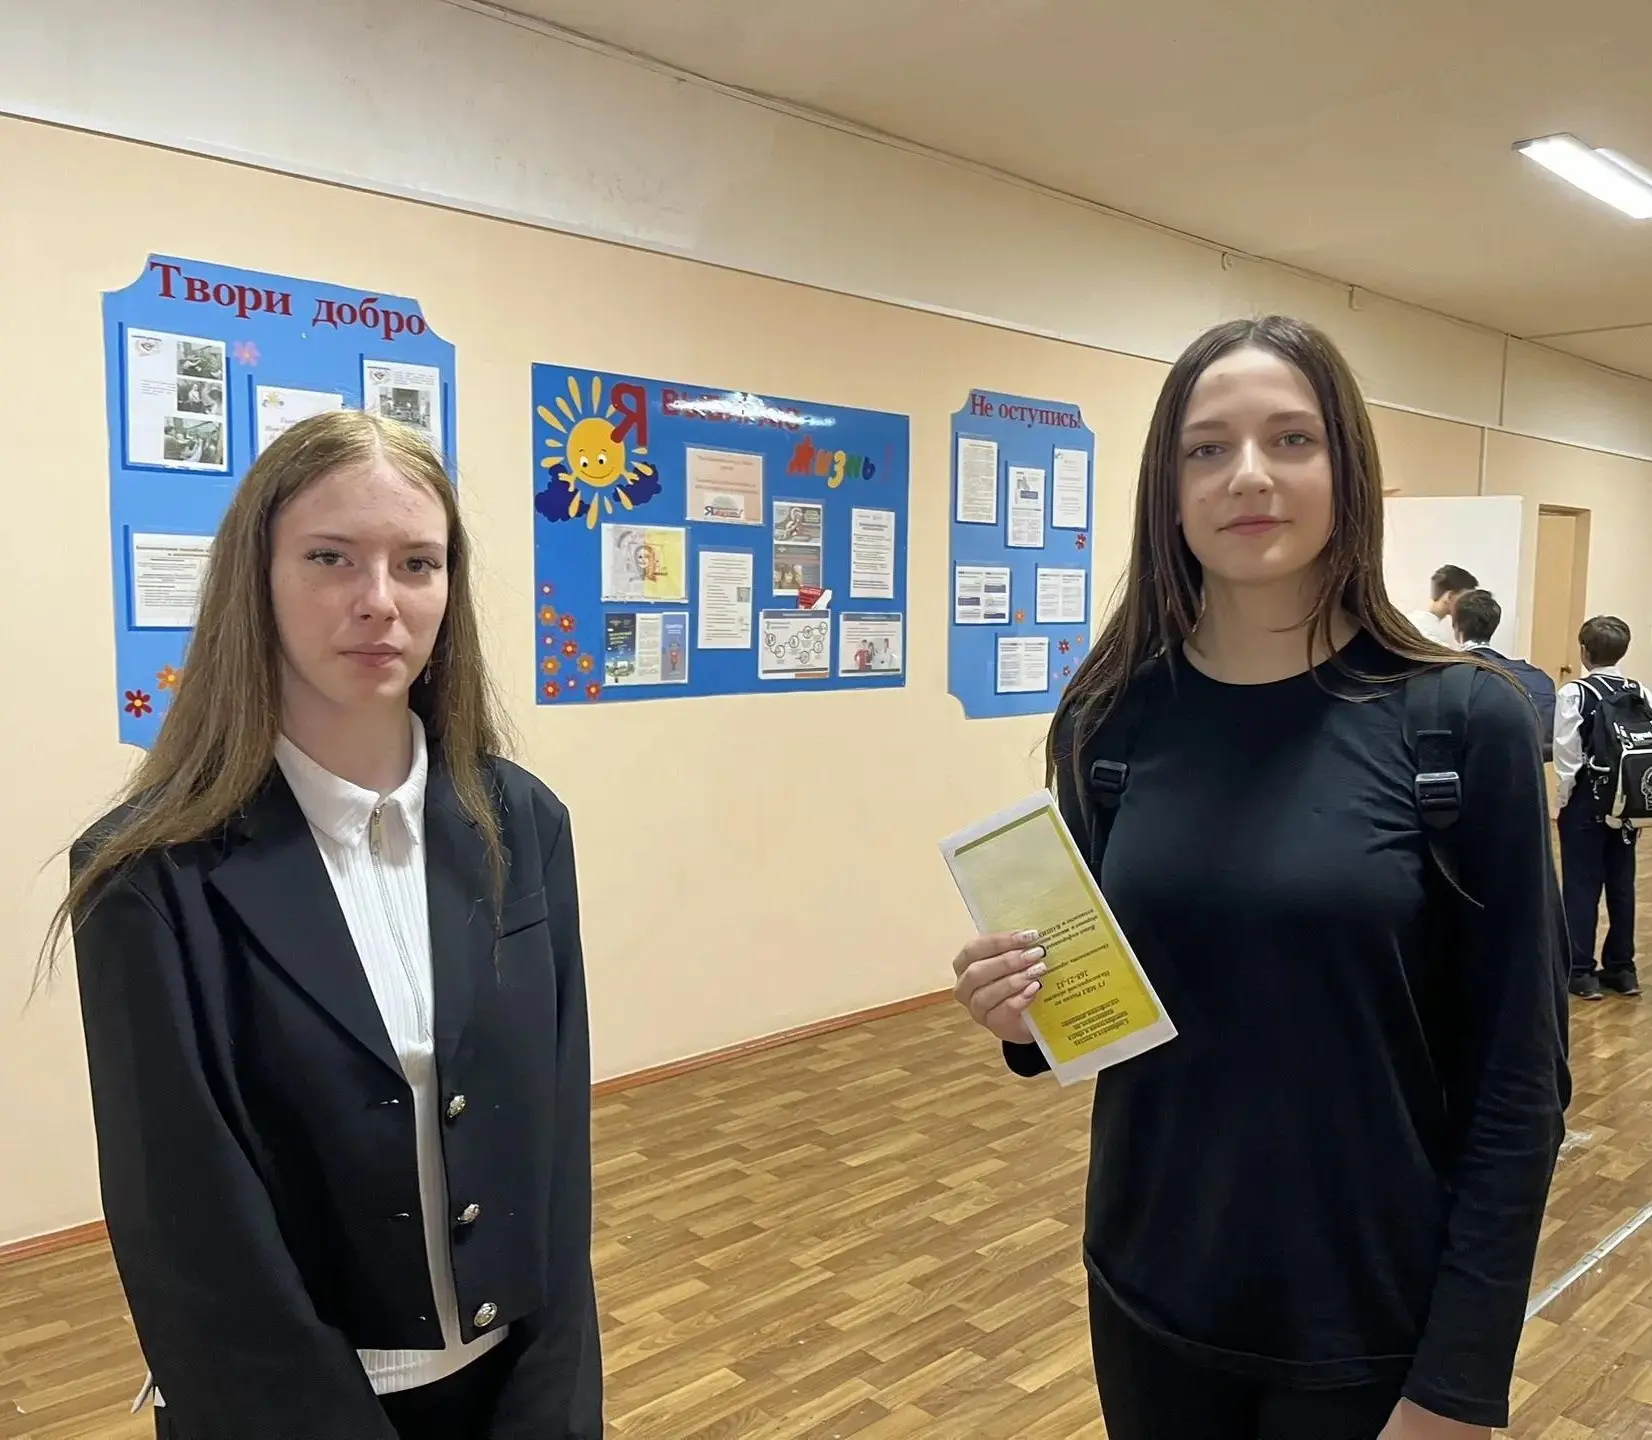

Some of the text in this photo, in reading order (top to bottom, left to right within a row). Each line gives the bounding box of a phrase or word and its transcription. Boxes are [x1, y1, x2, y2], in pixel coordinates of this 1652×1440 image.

[149, 262, 426, 341] Твори добро
[609, 382, 648, 448] Я
[969, 393, 1082, 429] Не оступись!
